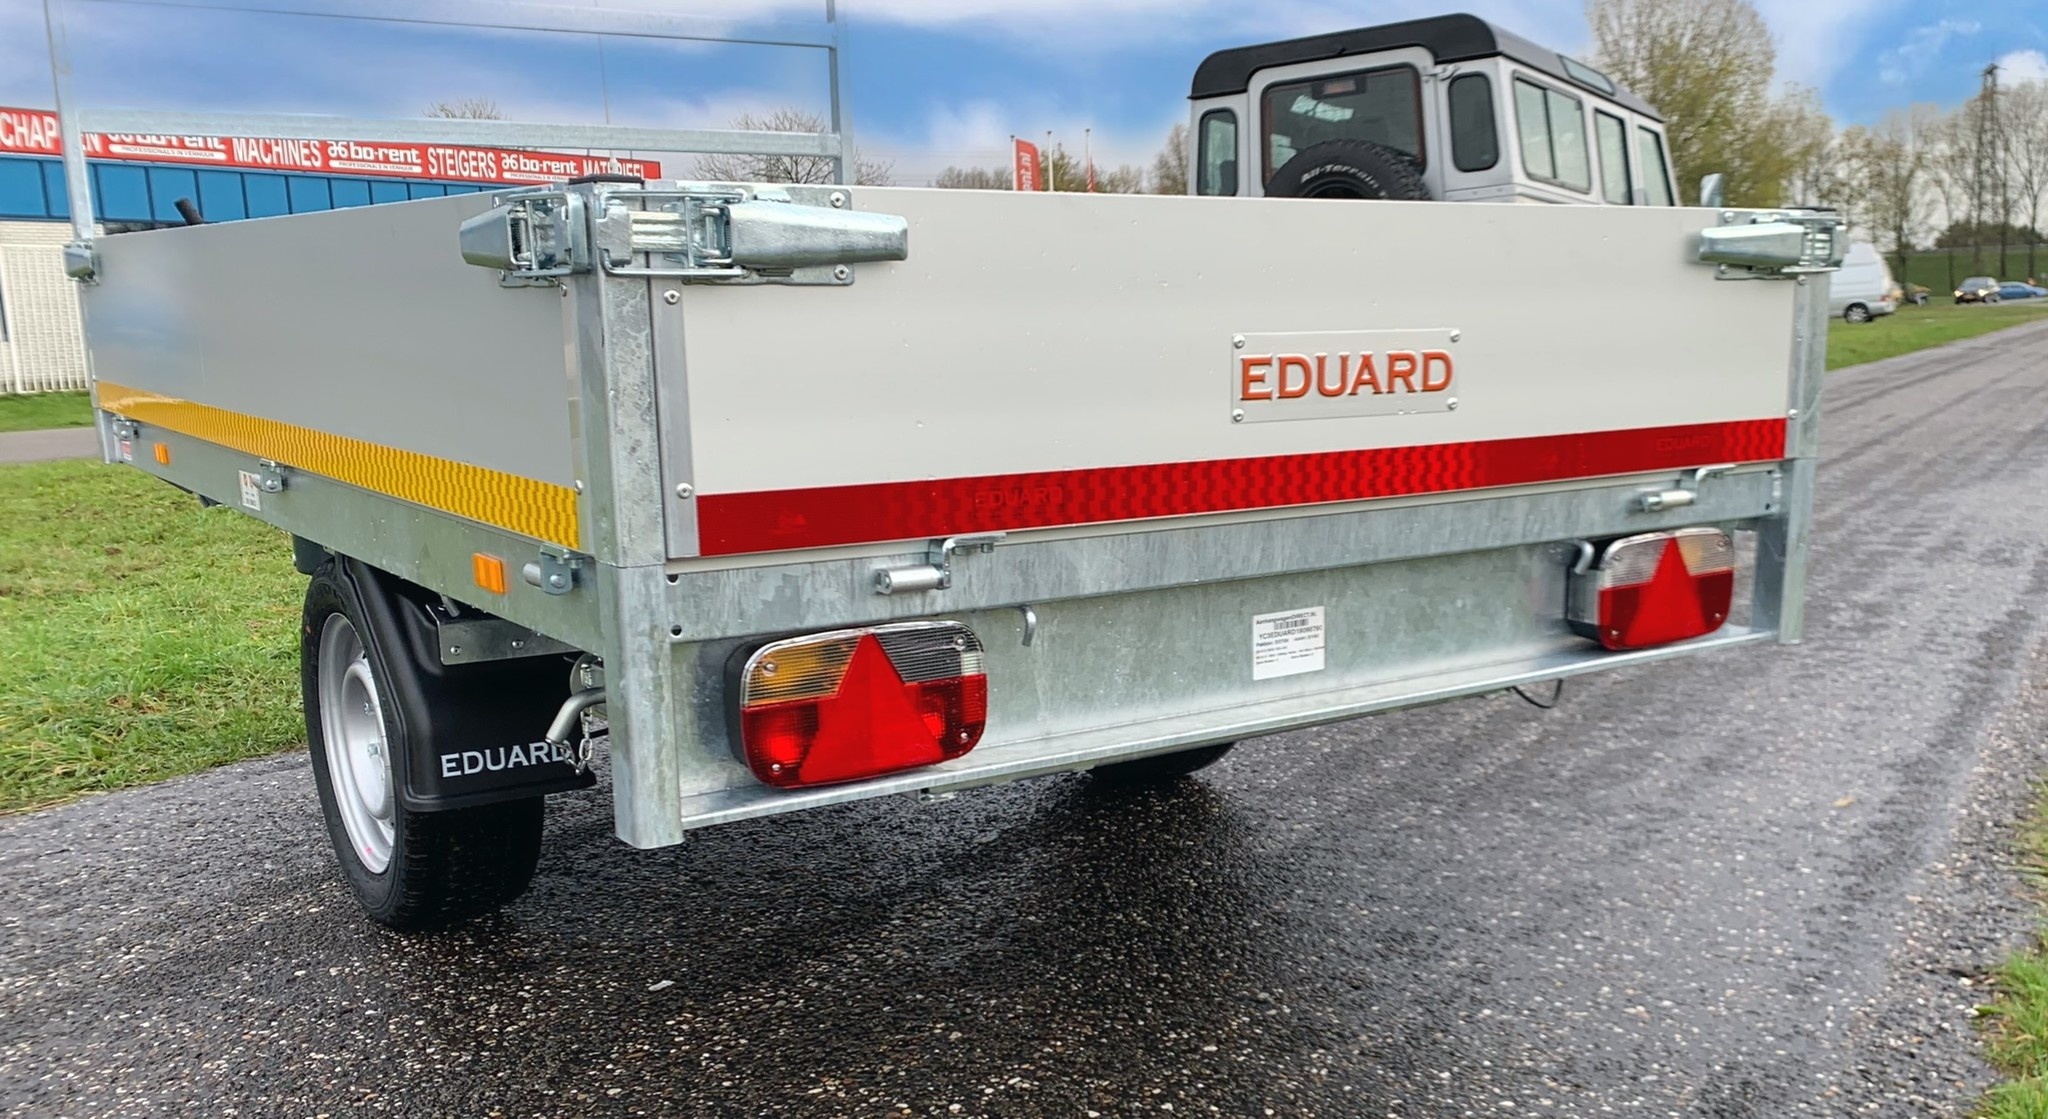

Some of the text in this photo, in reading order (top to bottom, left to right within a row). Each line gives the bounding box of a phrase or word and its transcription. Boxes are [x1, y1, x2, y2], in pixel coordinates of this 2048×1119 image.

[232, 138, 321, 167] MACHINES
[428, 147, 496, 178] STEIGERS
[1301, 163, 1380, 189] All-Terrain
[1239, 349, 1454, 401] EDUARD
[975, 486, 1063, 507] EDUARD
